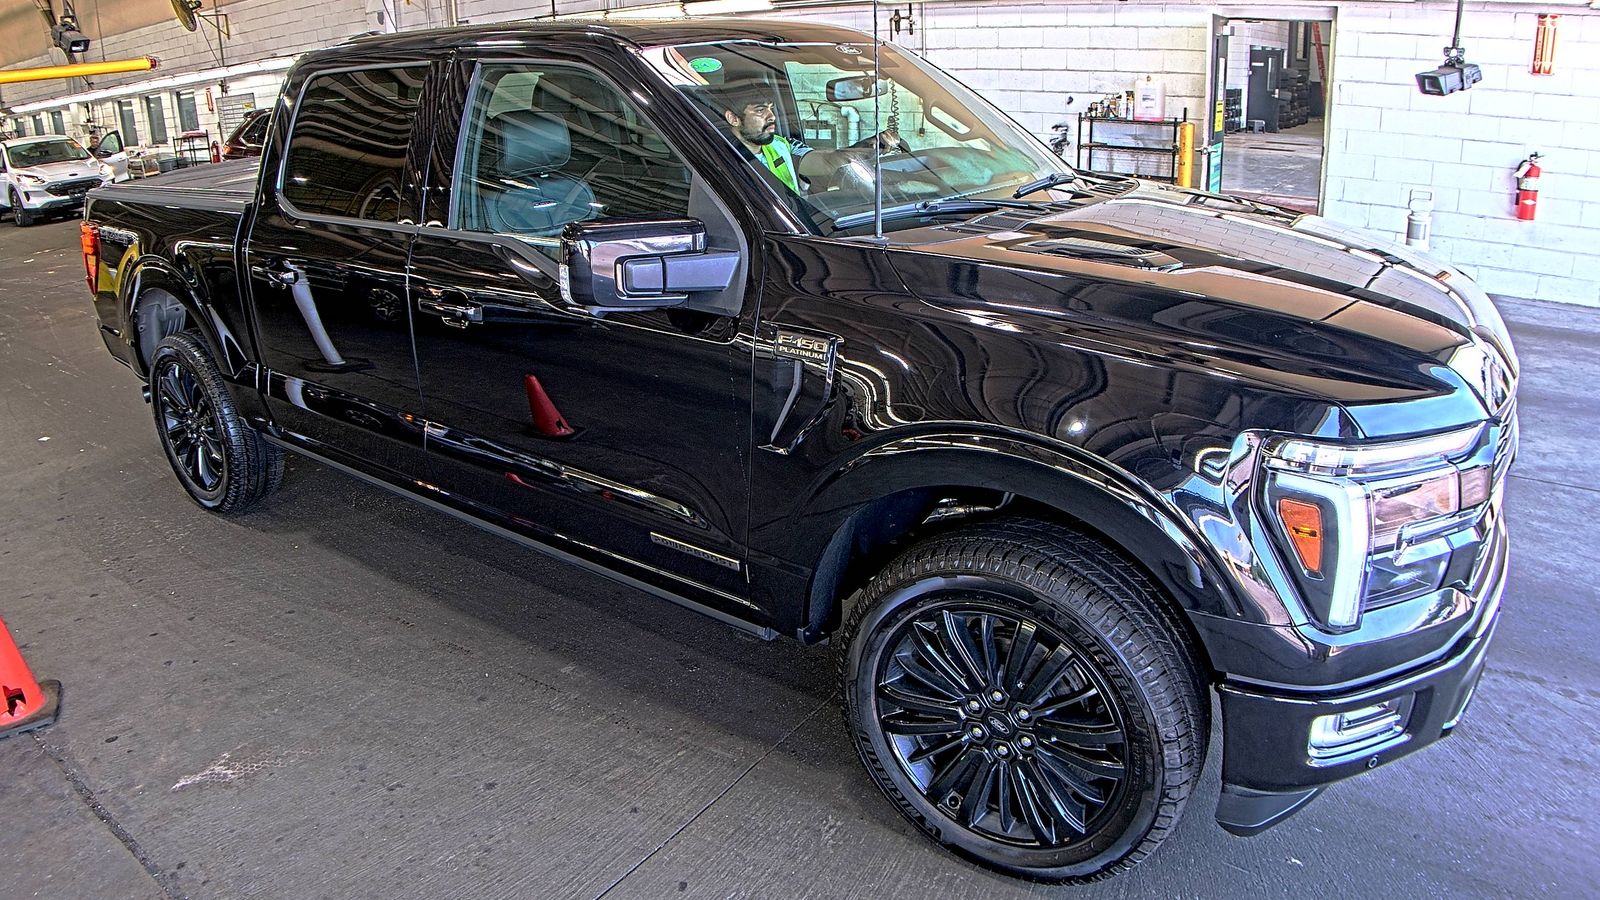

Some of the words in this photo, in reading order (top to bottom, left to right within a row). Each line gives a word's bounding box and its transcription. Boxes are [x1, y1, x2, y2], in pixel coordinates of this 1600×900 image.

[778, 334, 828, 353] F-150
[779, 346, 824, 360] PLATINUM
[1074, 632, 1145, 726] MICHELIN
[859, 733, 921, 818] MICHELIN
